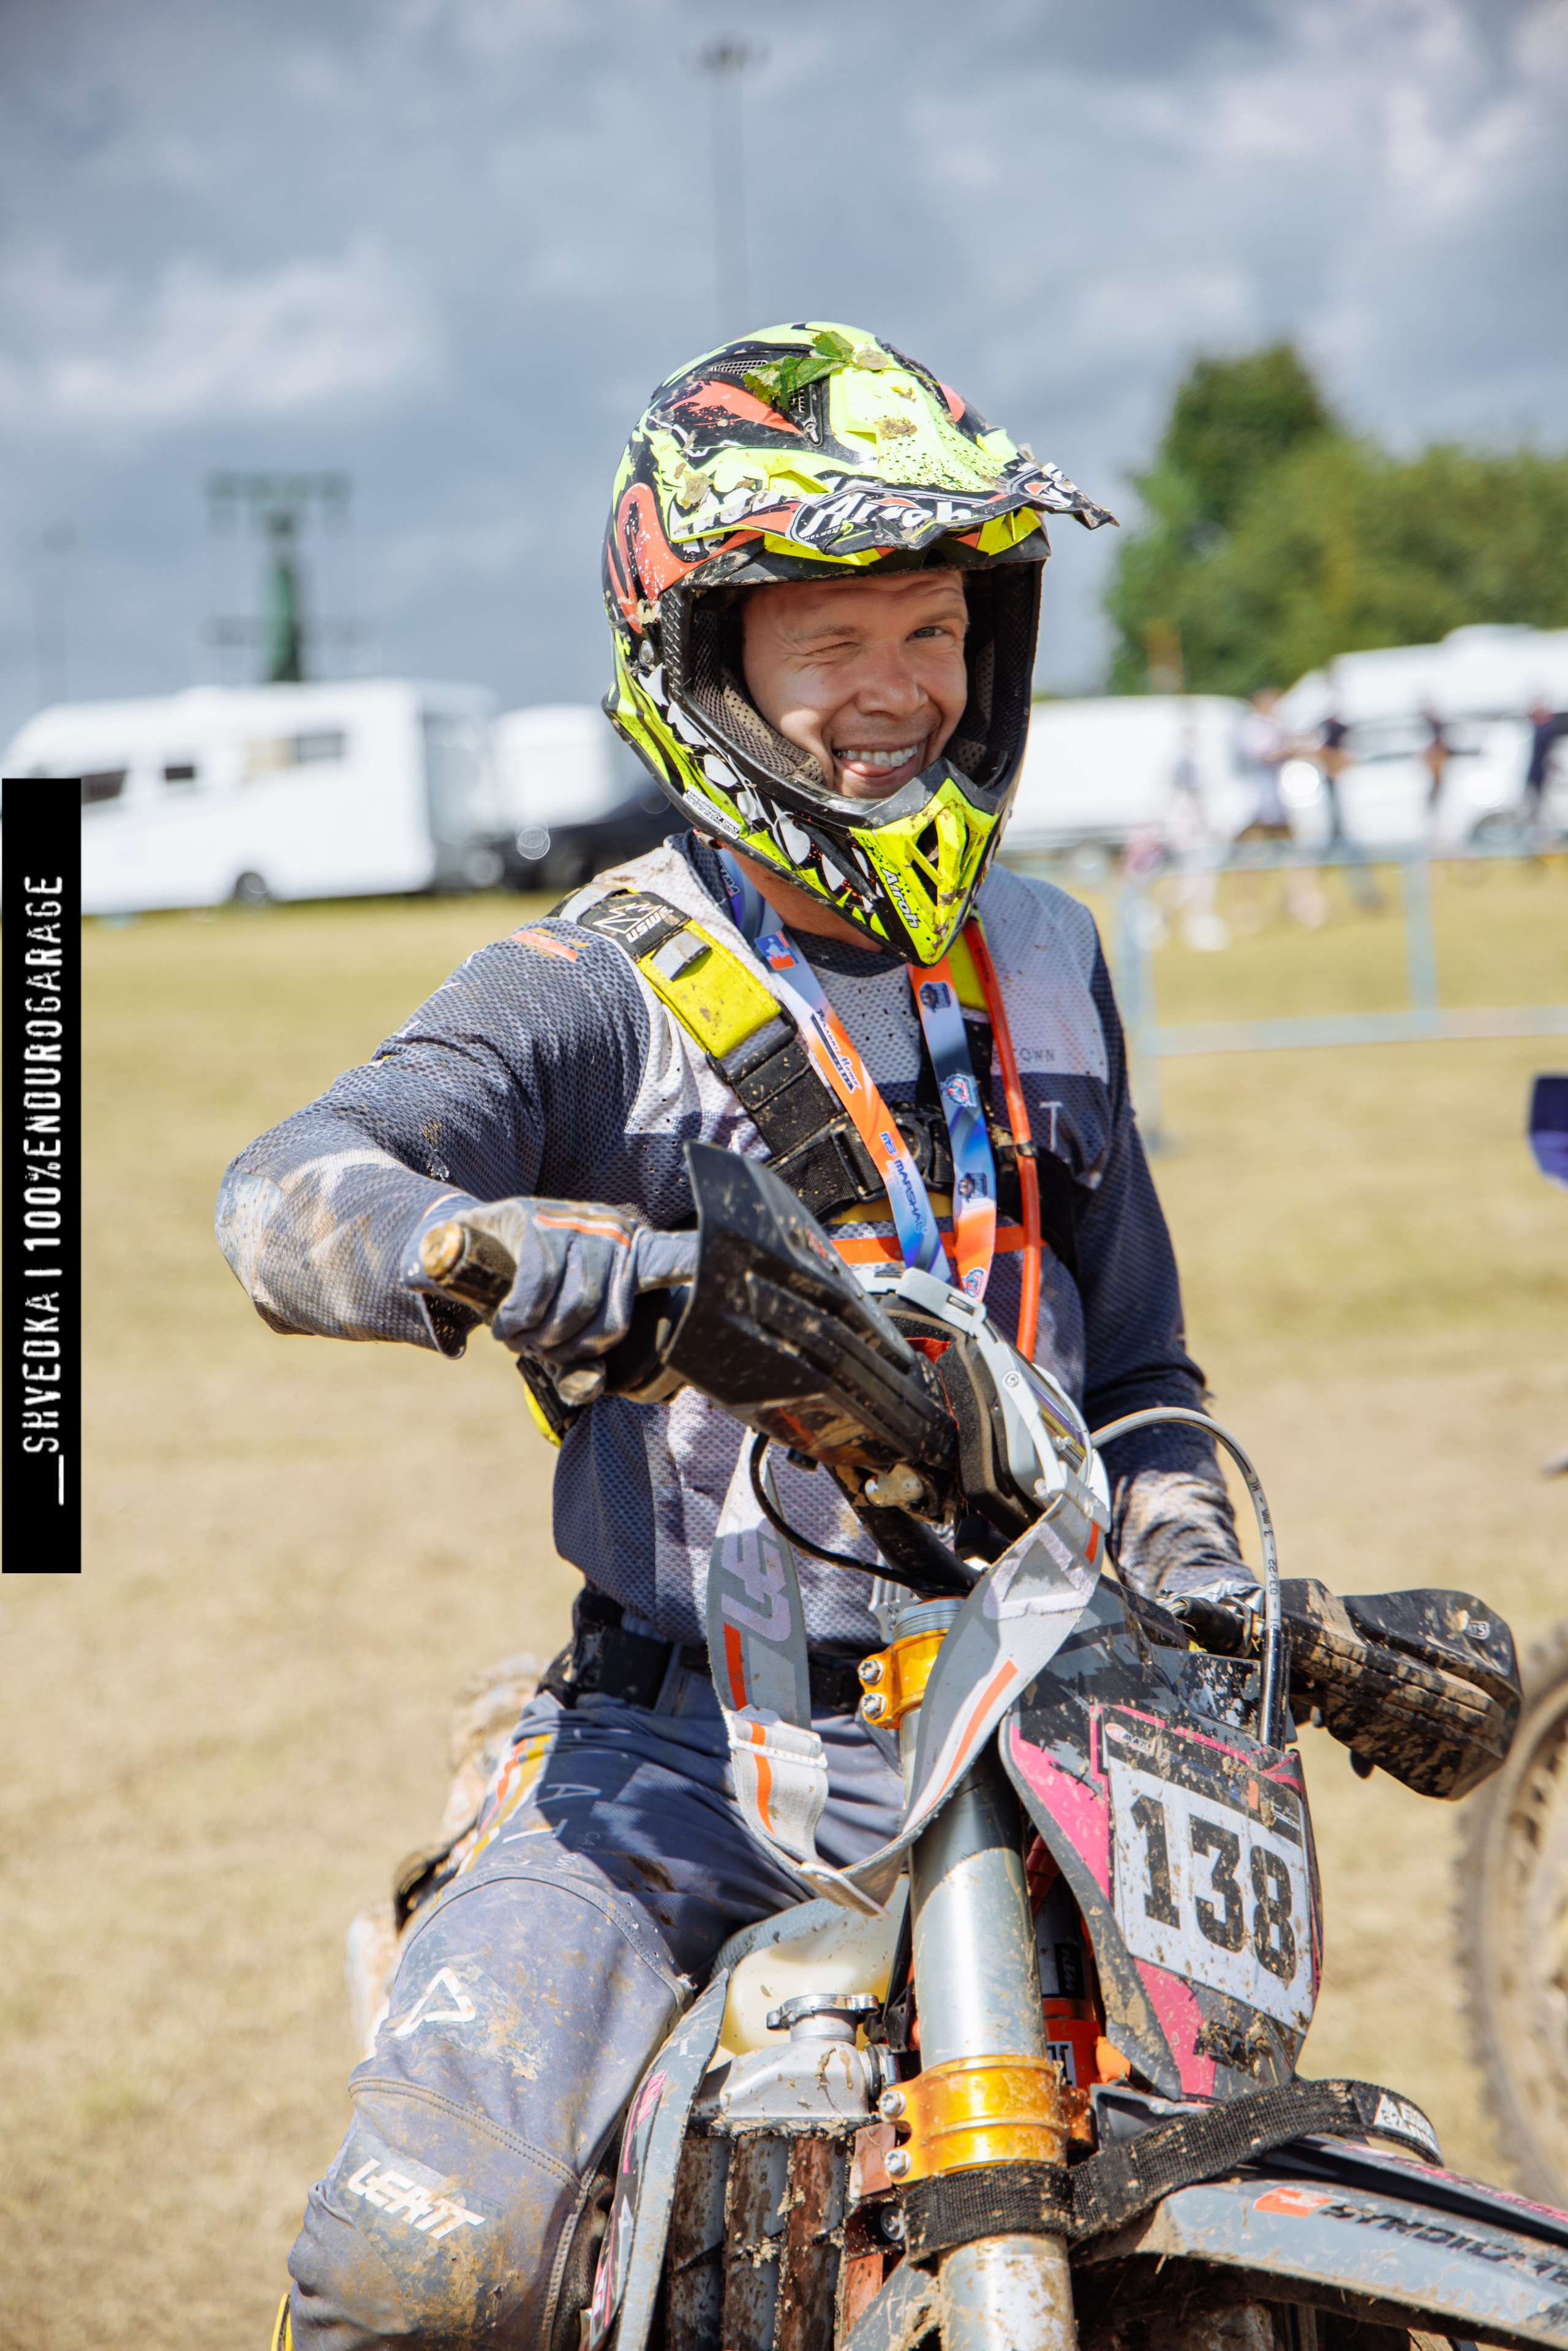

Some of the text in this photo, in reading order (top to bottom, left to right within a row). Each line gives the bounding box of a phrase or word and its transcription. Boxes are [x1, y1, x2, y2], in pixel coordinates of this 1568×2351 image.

[687, 791, 740, 834] EMERGENCY ONLY
[881, 867, 919, 928] Airoh
[1014, 1047, 1054, 1062] OWN
[1264, 1530, 1273, 1538] 3
[1268, 1558, 1279, 1595] 03/22
[1130, 1794, 1298, 1983] 138
[347, 2157, 486, 2240] LEATT
